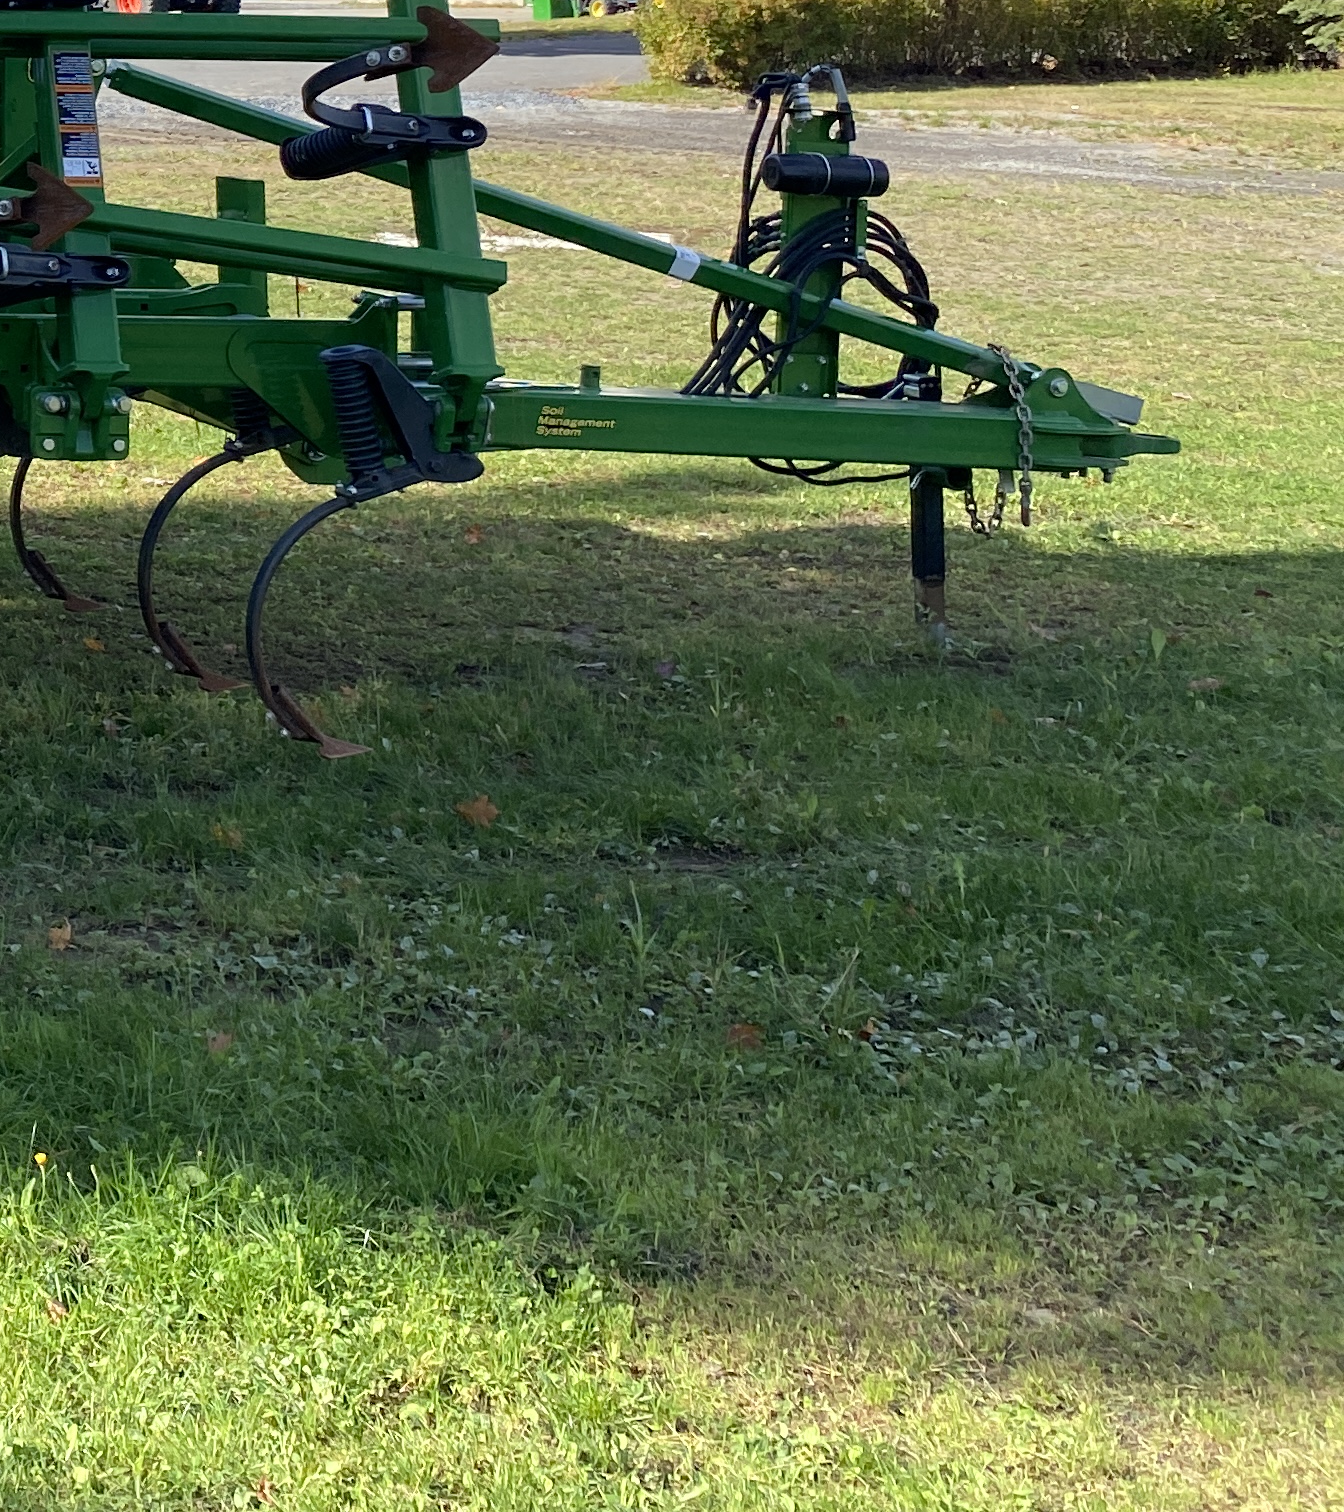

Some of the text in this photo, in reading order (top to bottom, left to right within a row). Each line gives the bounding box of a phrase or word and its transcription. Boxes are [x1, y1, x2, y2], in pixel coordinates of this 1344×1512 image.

[541, 405, 565, 416] Soil
[537, 415, 617, 429] Management
[535, 425, 582, 437] System
